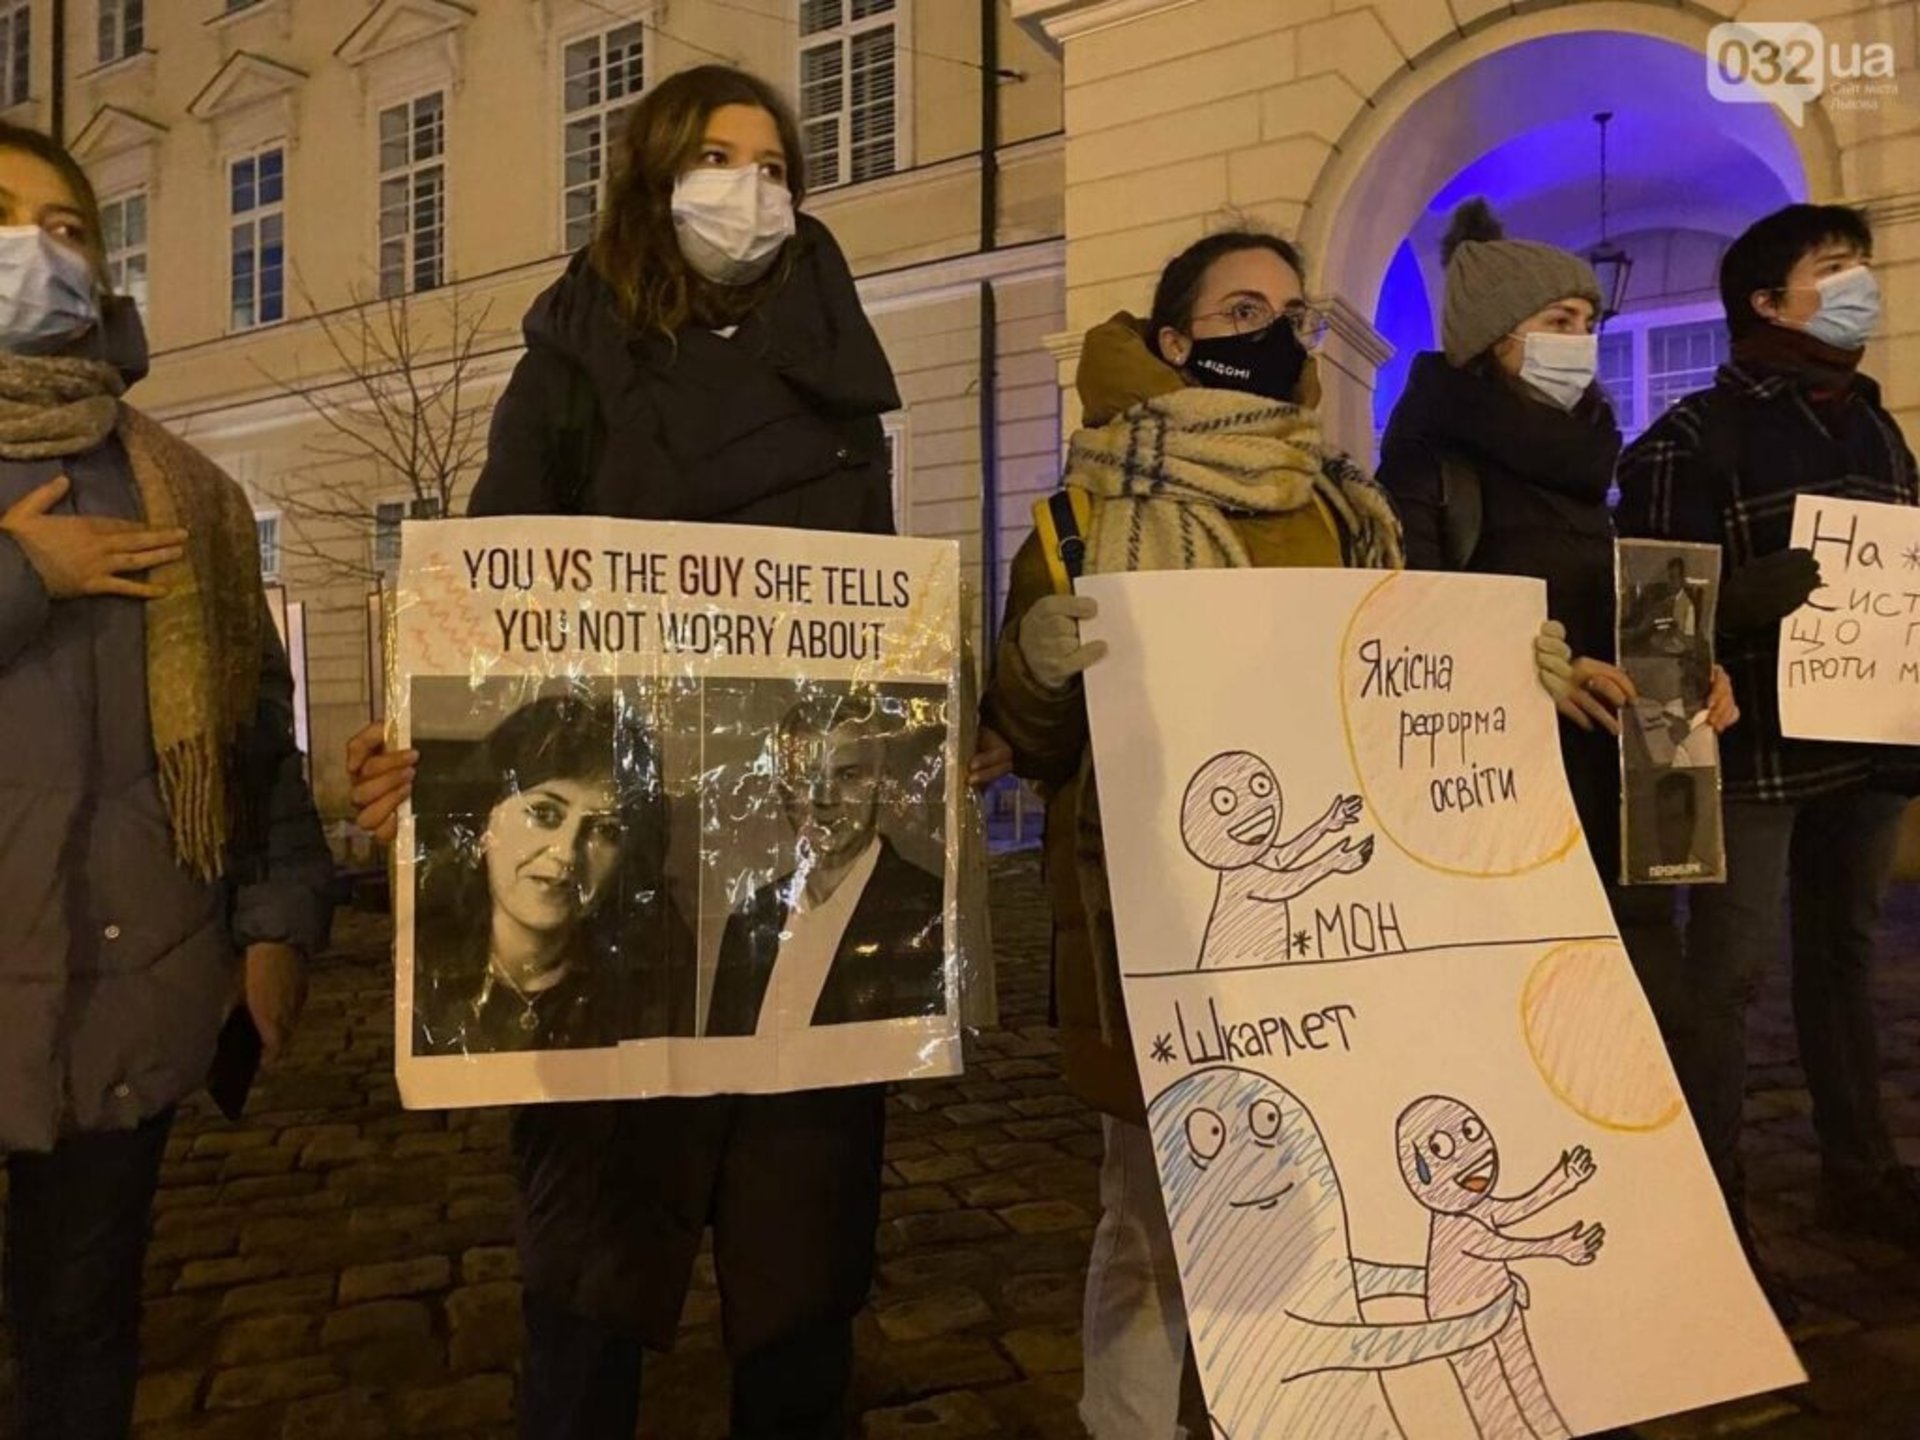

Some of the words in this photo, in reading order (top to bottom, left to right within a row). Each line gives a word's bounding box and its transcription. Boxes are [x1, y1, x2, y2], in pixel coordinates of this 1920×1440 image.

[1811, 510, 1884, 571] На
[463, 548, 534, 592] YOU
[546, 549, 593, 592] VS
[603, 551, 667, 595] THE
[679, 555, 745, 599] GUY
[755, 558, 812, 604] SHE
[822, 566, 910, 608] TELLS
[495, 609, 567, 652] YOU
[579, 611, 647, 653] NOT
[660, 613, 779, 657] WORRY
[786, 620, 886, 661] ABOUT
[1359, 638, 1454, 698] Якісна
[1399, 706, 1507, 769] реформа
[1430, 763, 1517, 813] освіти
